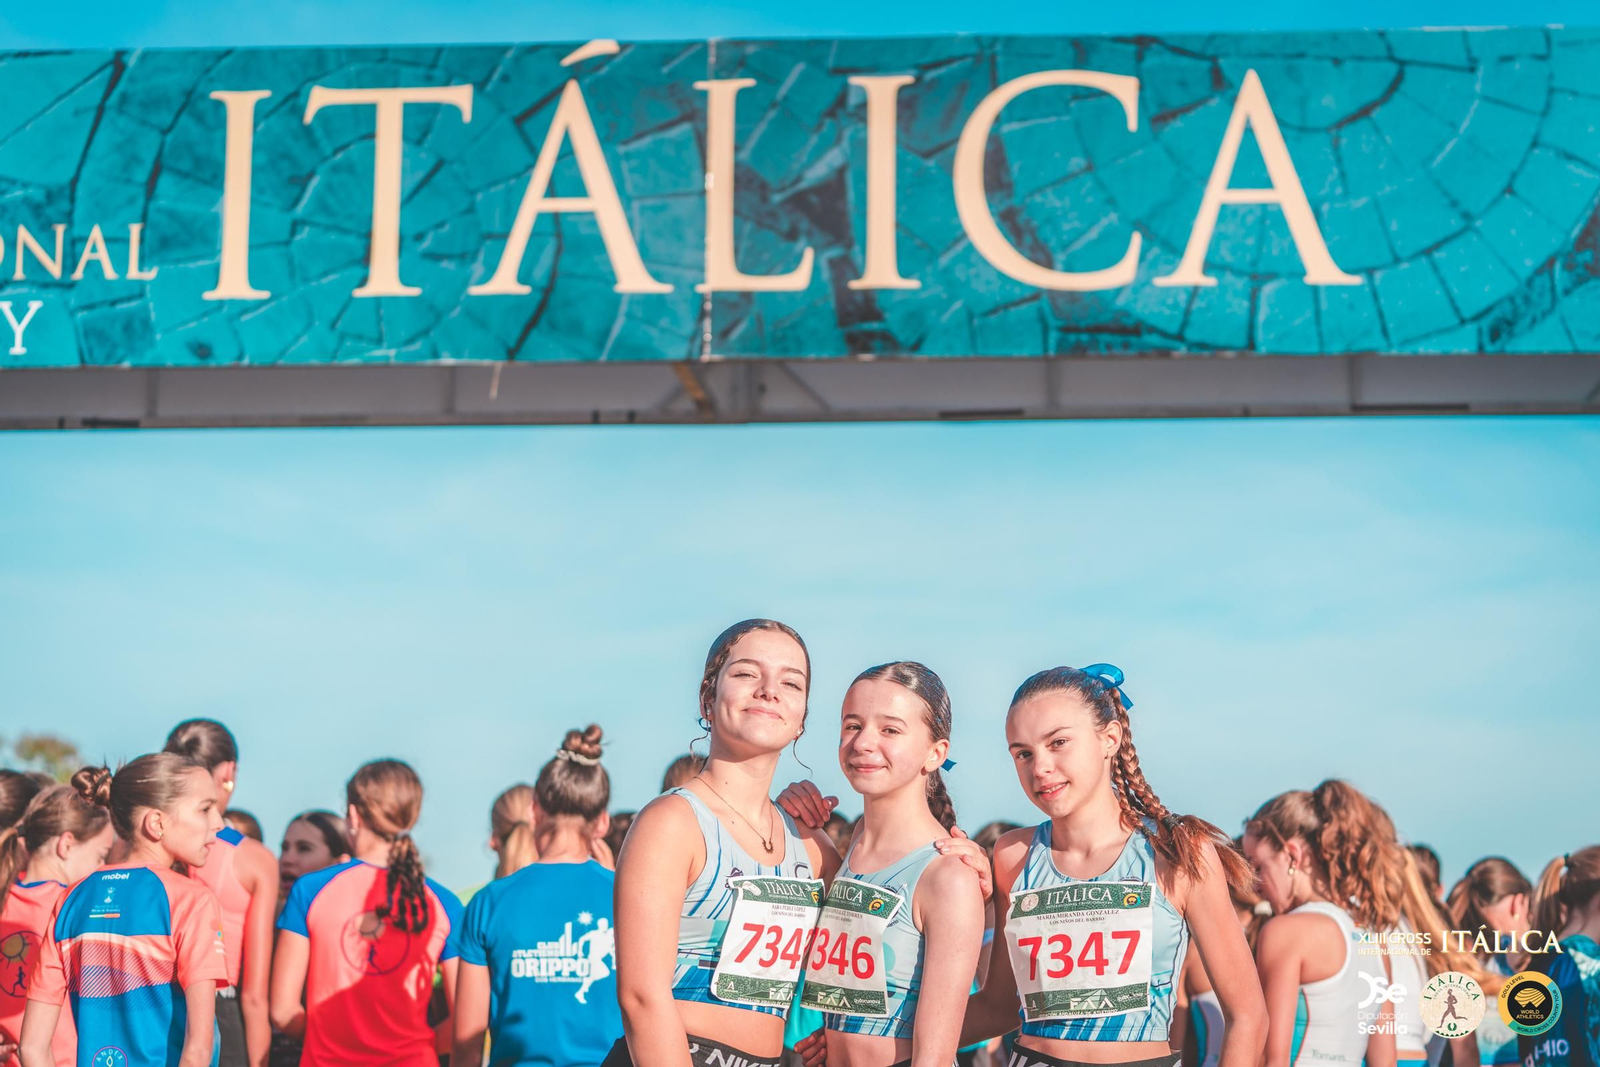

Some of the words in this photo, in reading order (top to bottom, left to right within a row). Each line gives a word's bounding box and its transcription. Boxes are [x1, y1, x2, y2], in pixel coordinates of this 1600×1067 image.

[202, 39, 1364, 301] ITÁLICA
[0, 223, 159, 281] NAL
[763, 879, 807, 898] ITÁLICA
[1046, 886, 1113, 906] ITÁLICA
[1057, 911, 1085, 919] MIRANDA
[1017, 930, 1141, 981] 7347
